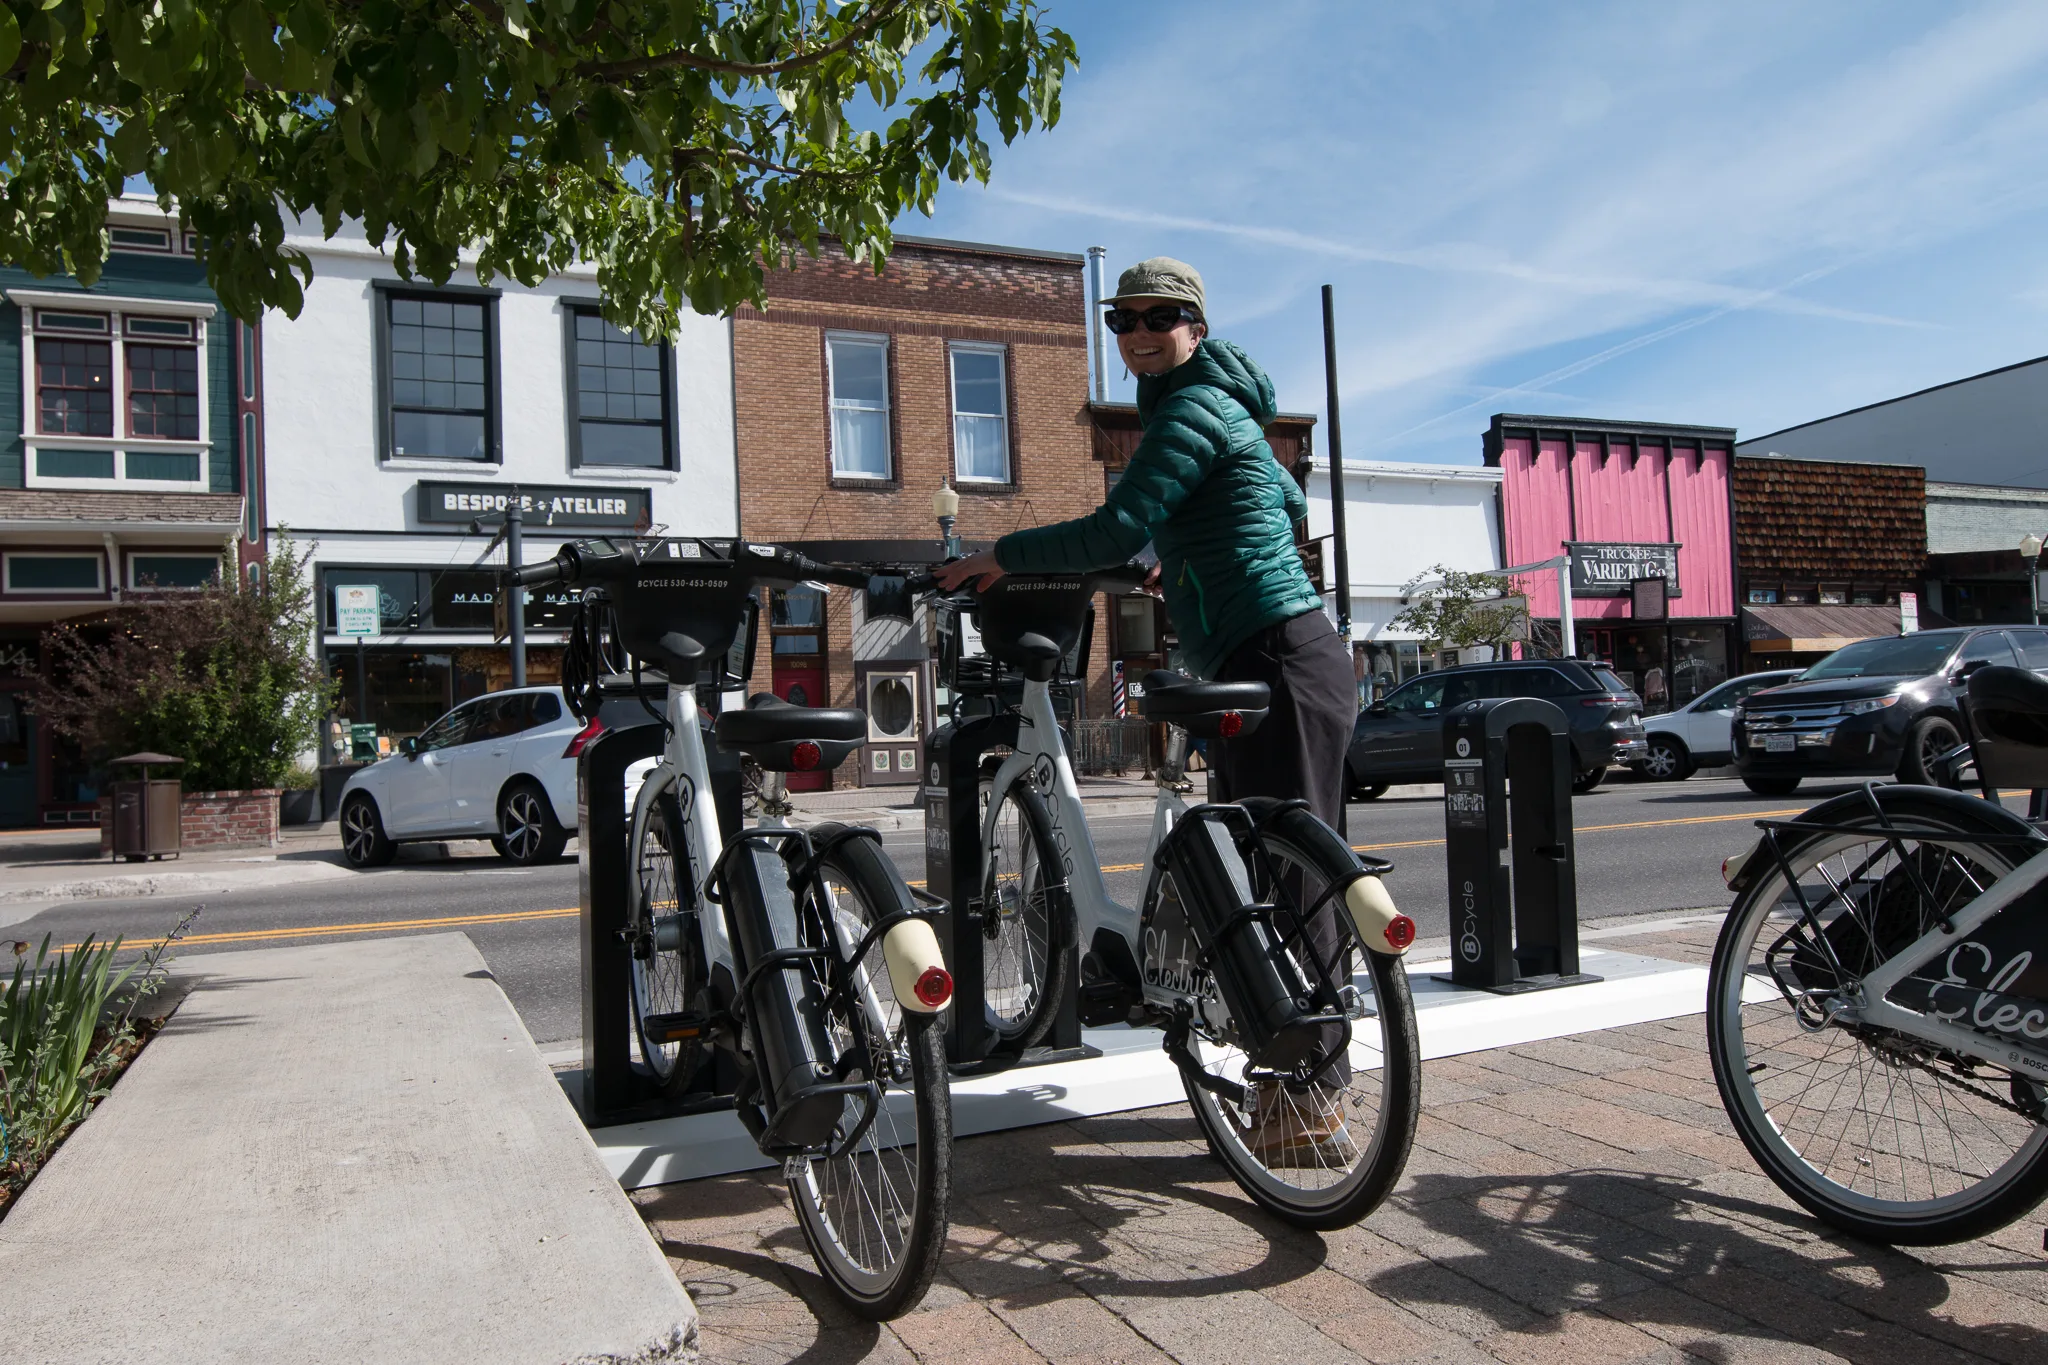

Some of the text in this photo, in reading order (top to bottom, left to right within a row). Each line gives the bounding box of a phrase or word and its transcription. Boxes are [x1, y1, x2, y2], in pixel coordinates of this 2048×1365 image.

[444, 493, 627, 515] BESPOE ATELIER
[1598, 549, 1652, 560] TRUCKEE
[637, 579, 729, 588] BCYCLE 530-453-0509
[1006, 583, 1032, 591] BCYCLE
[454, 593, 580, 602] MAD MAK
[340, 607, 376, 615] PAY PARKING
[1458, 744, 1467, 752] 01
[1144, 926, 1214, 998] Electric
[2023, 1057, 2048, 1073] BOSC
